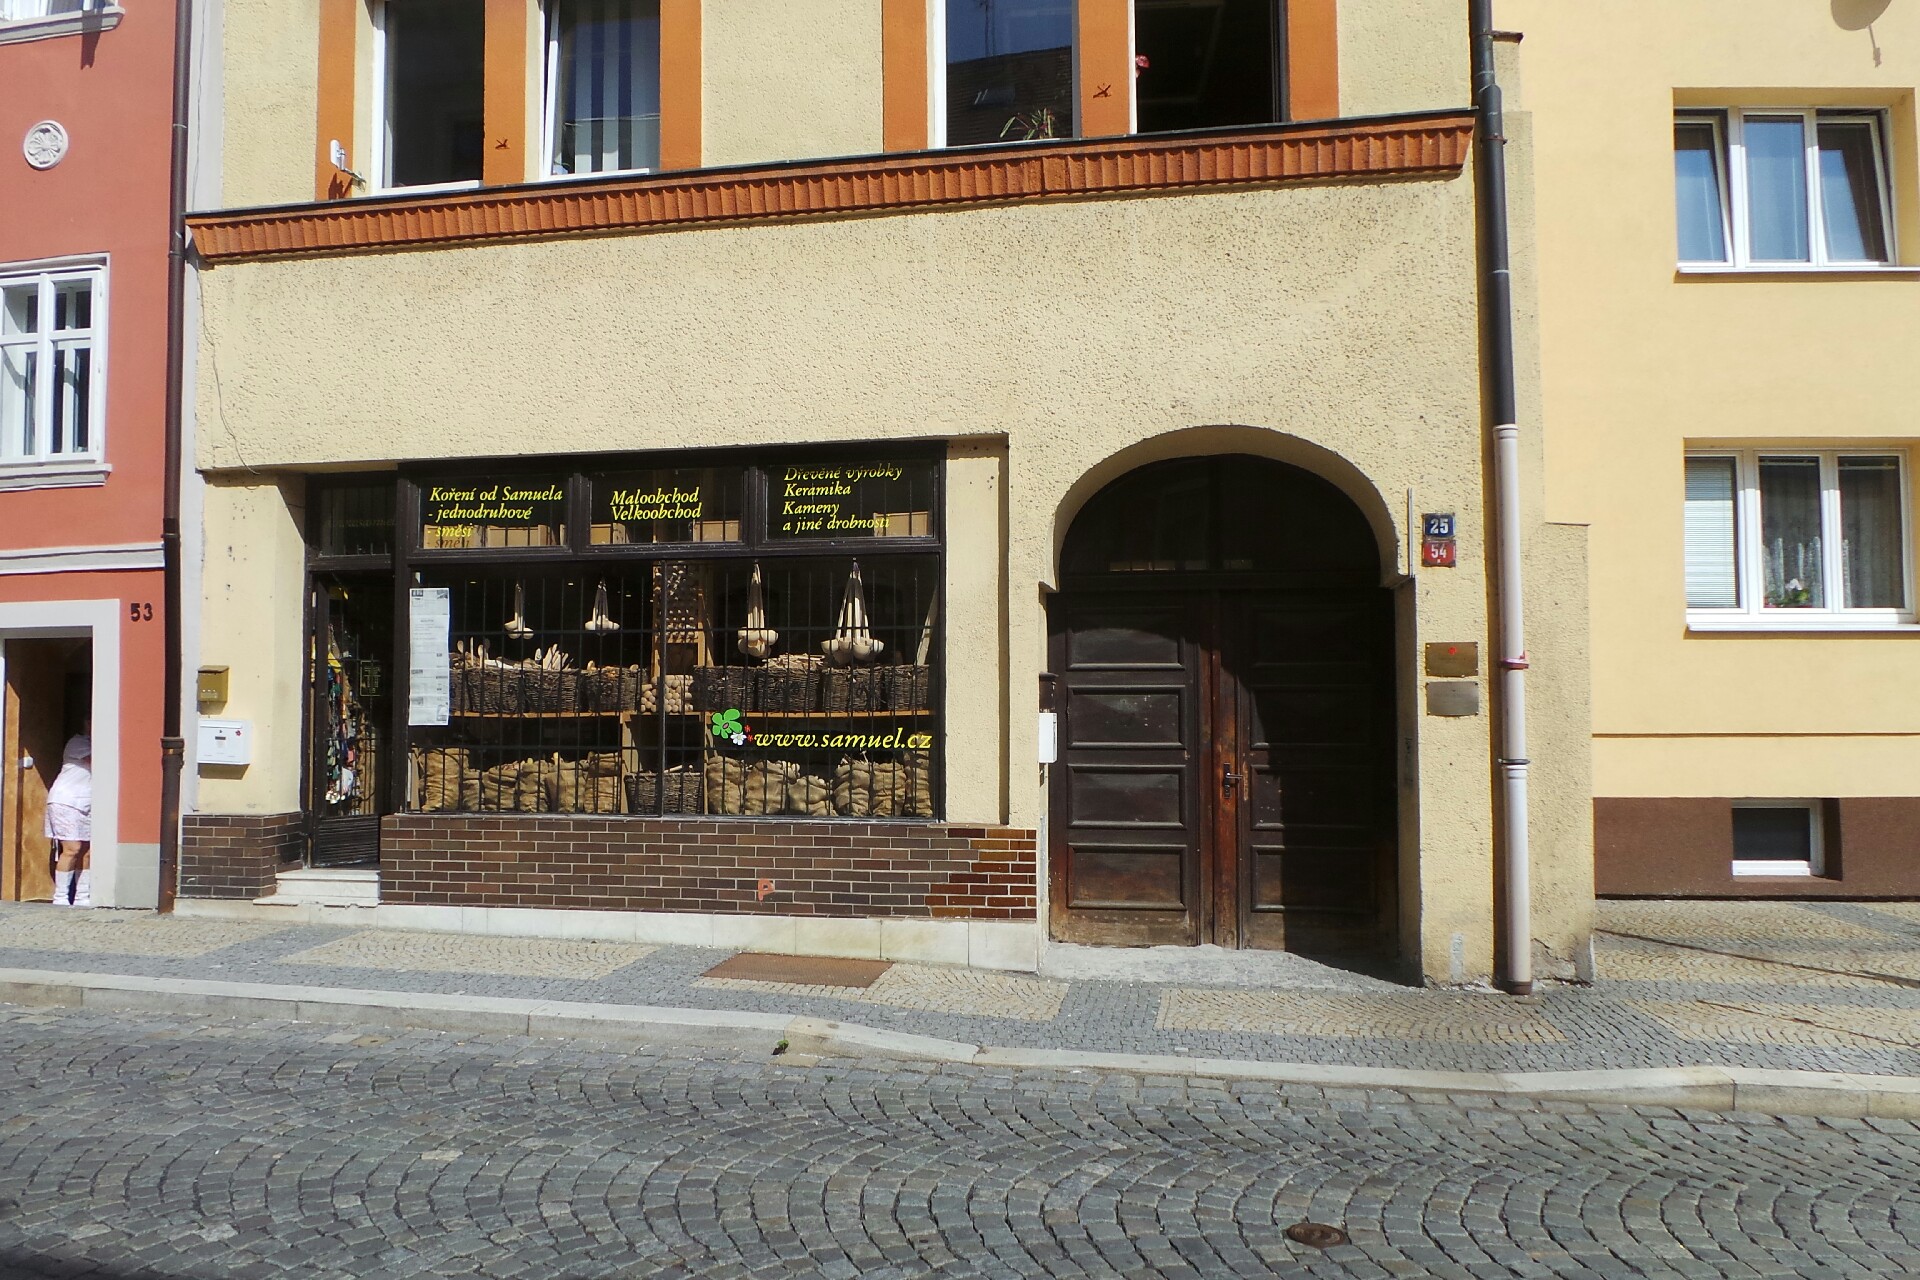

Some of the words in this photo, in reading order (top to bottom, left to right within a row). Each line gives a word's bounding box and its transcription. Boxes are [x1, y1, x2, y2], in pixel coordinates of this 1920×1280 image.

[784, 466, 842, 481] Dřevěné
[845, 463, 903, 482] výrobky
[429, 487, 477, 502] Koření
[479, 485, 498, 501] od
[501, 485, 563, 501] Samuela
[610, 486, 700, 506] Maloobchod
[783, 480, 852, 497] Keramika
[435, 502, 534, 523] jednodruhové
[612, 502, 703, 521] Velkoobchod
[782, 500, 840, 517] Kameny
[782, 521, 792, 531] a
[794, 516, 823, 535] jiné
[826, 514, 891, 530] drobnosti
[1430, 518, 1449, 535] 25
[1431, 543, 1447, 559] 54
[129, 602, 154, 623] 53
[754, 727, 934, 750] www.samuel.cz
